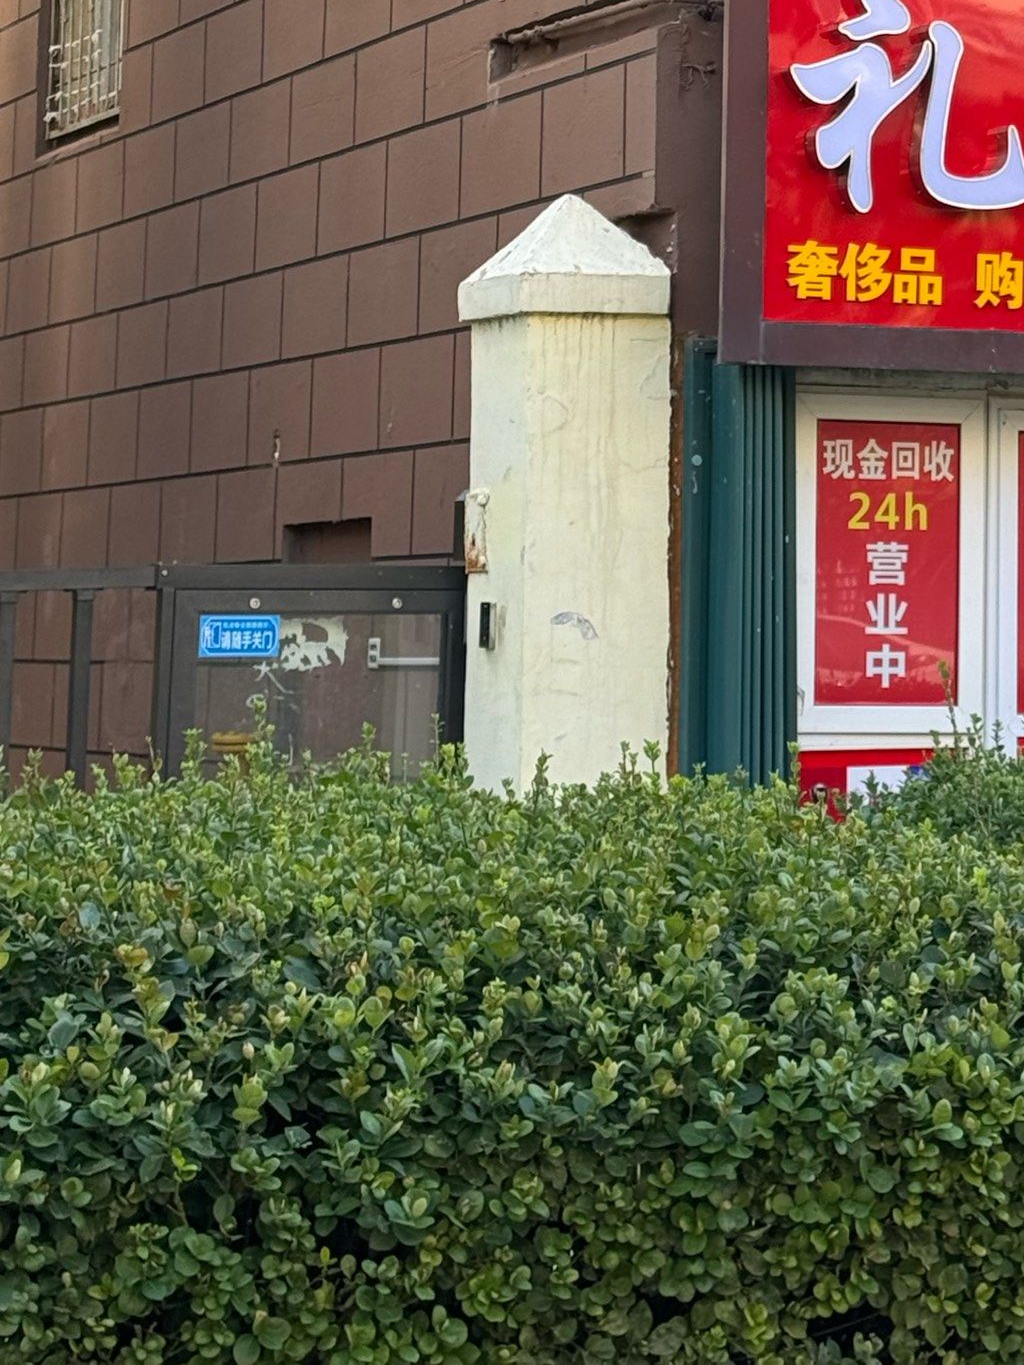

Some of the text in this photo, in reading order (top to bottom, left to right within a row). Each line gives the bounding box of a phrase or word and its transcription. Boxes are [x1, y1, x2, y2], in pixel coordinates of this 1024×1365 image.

[787, 240, 943, 307] 奢侈品
[822, 438, 955, 482] 现金回收
[847, 491, 929, 531] 24h
[865, 541, 908, 689] 营业中
